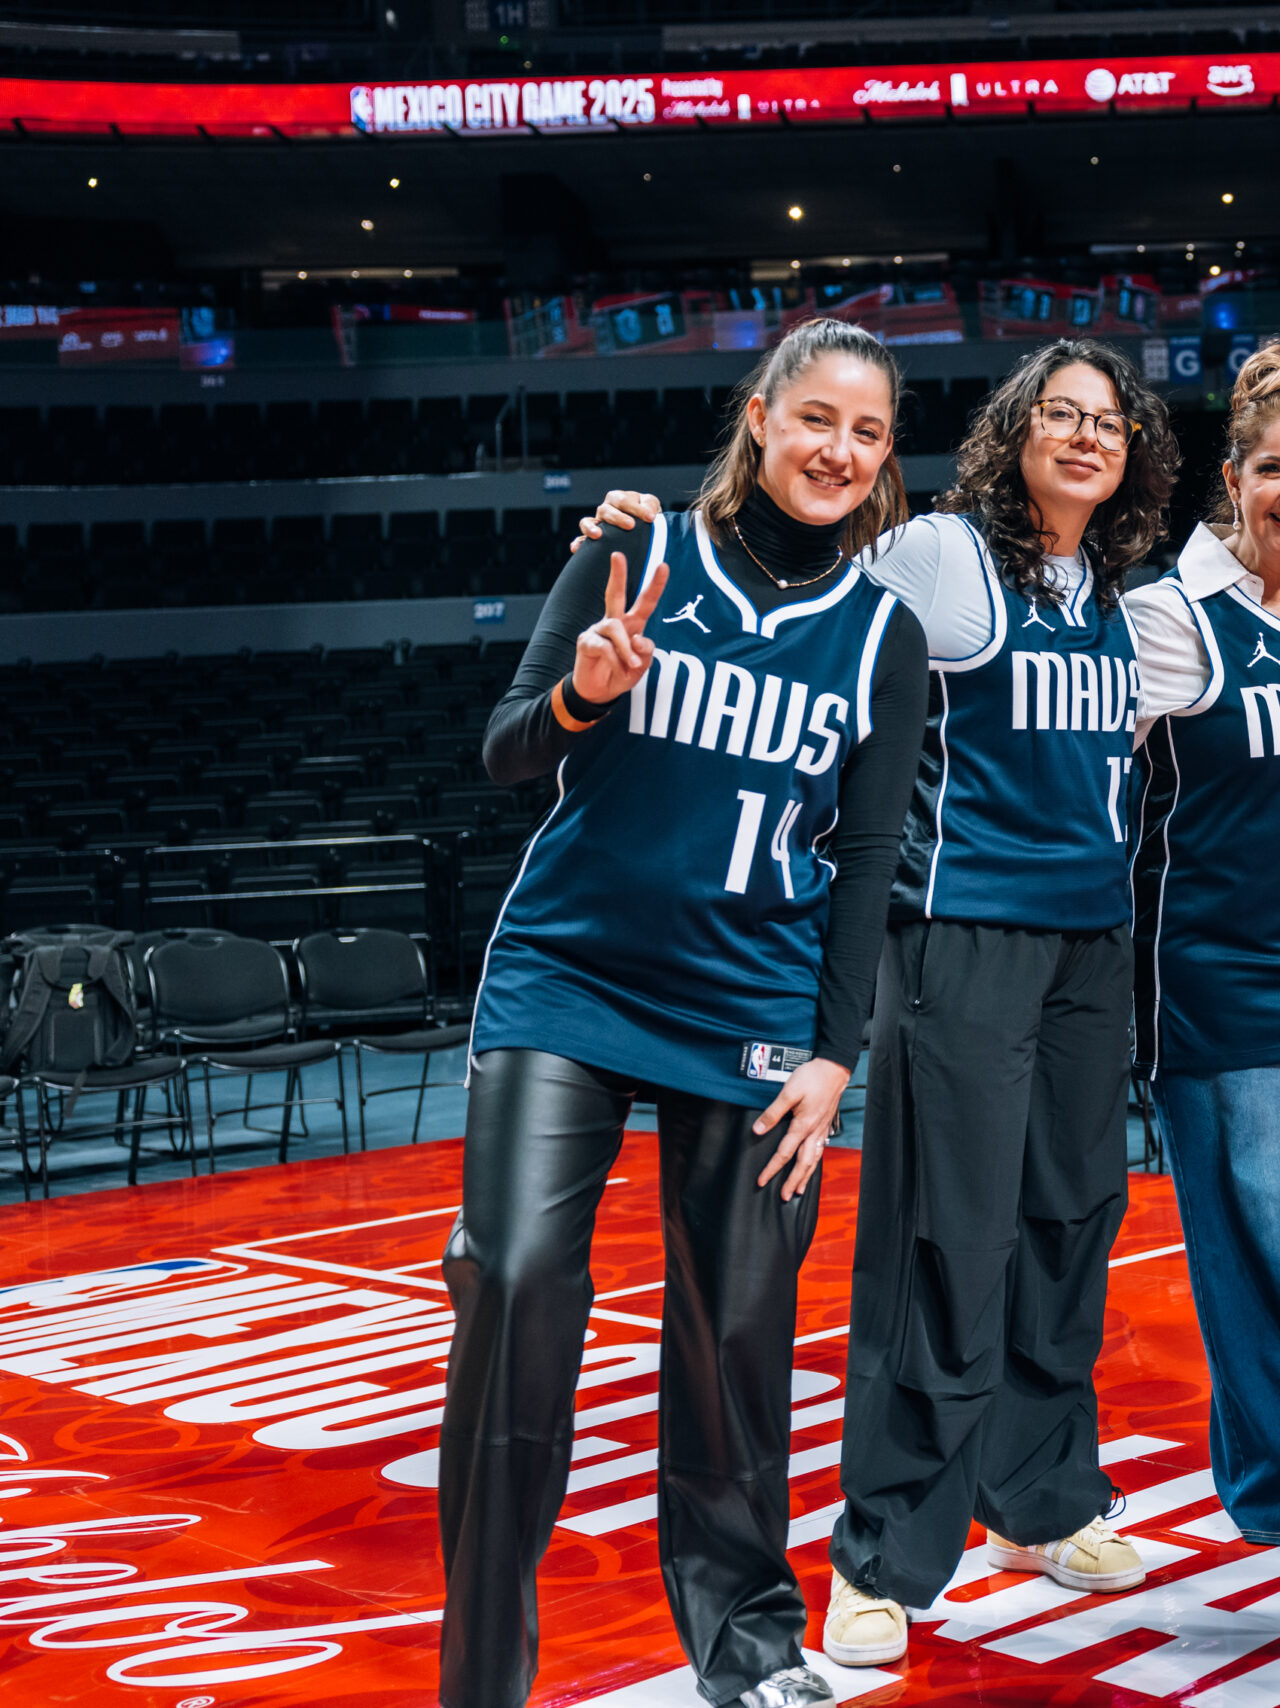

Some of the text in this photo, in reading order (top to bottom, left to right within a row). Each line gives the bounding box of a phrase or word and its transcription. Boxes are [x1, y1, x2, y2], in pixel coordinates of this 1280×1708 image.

[976, 78, 1059, 97] ULTRA
[1117, 72, 1177, 95] AT&T
[373, 78, 656, 131] MEXICO CITY GAME 2025
[1175, 349, 1200, 377] G
[629, 647, 849, 776] MAVS
[724, 788, 803, 899] 14
